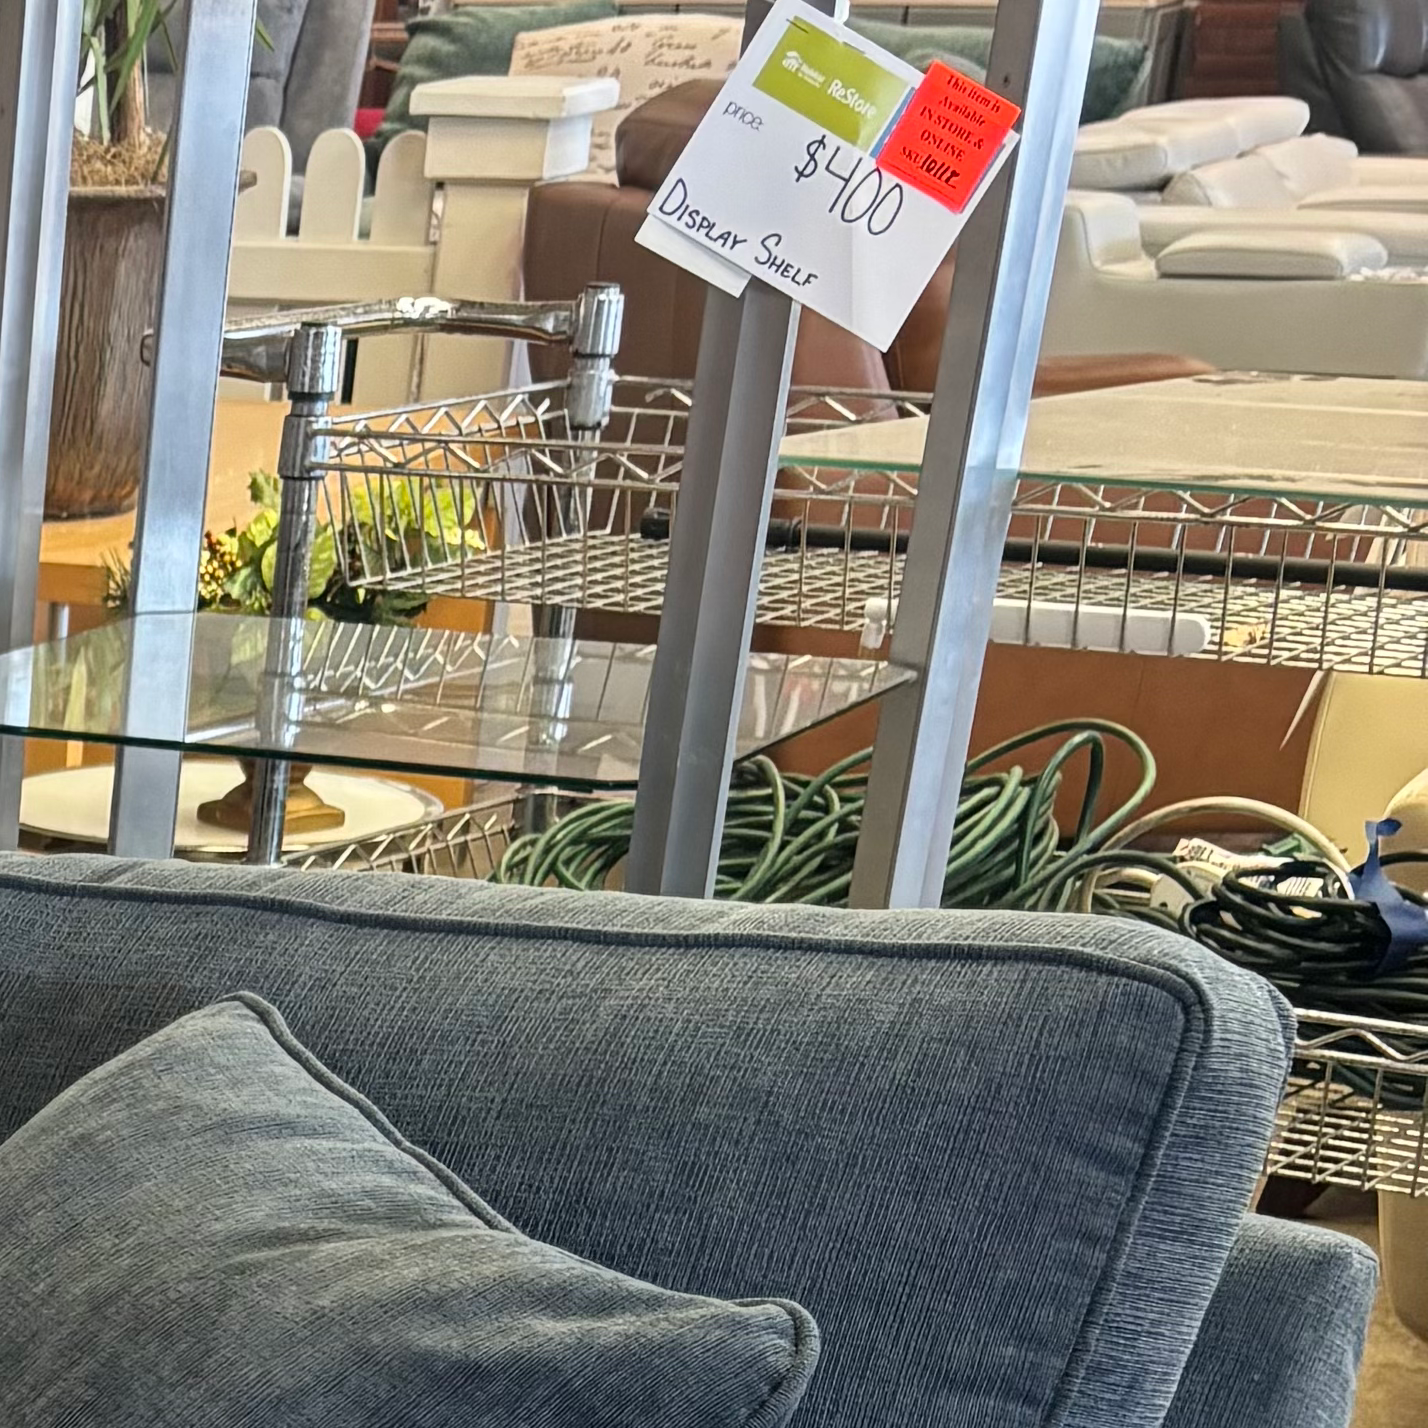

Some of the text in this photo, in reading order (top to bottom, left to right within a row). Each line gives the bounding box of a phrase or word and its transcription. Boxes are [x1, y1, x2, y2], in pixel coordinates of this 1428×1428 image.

[826, 78, 878, 119] ReStore
[938, 95, 986, 127] Available
[947, 74, 1001, 113] This item is
[722, 100, 766, 132] price:
[919, 105, 985, 151] IN STORE &
[920, 128, 966, 162] ONLINE
[794, 134, 905, 237] $400
[658, 178, 820, 288] DISPLAY SHELF
